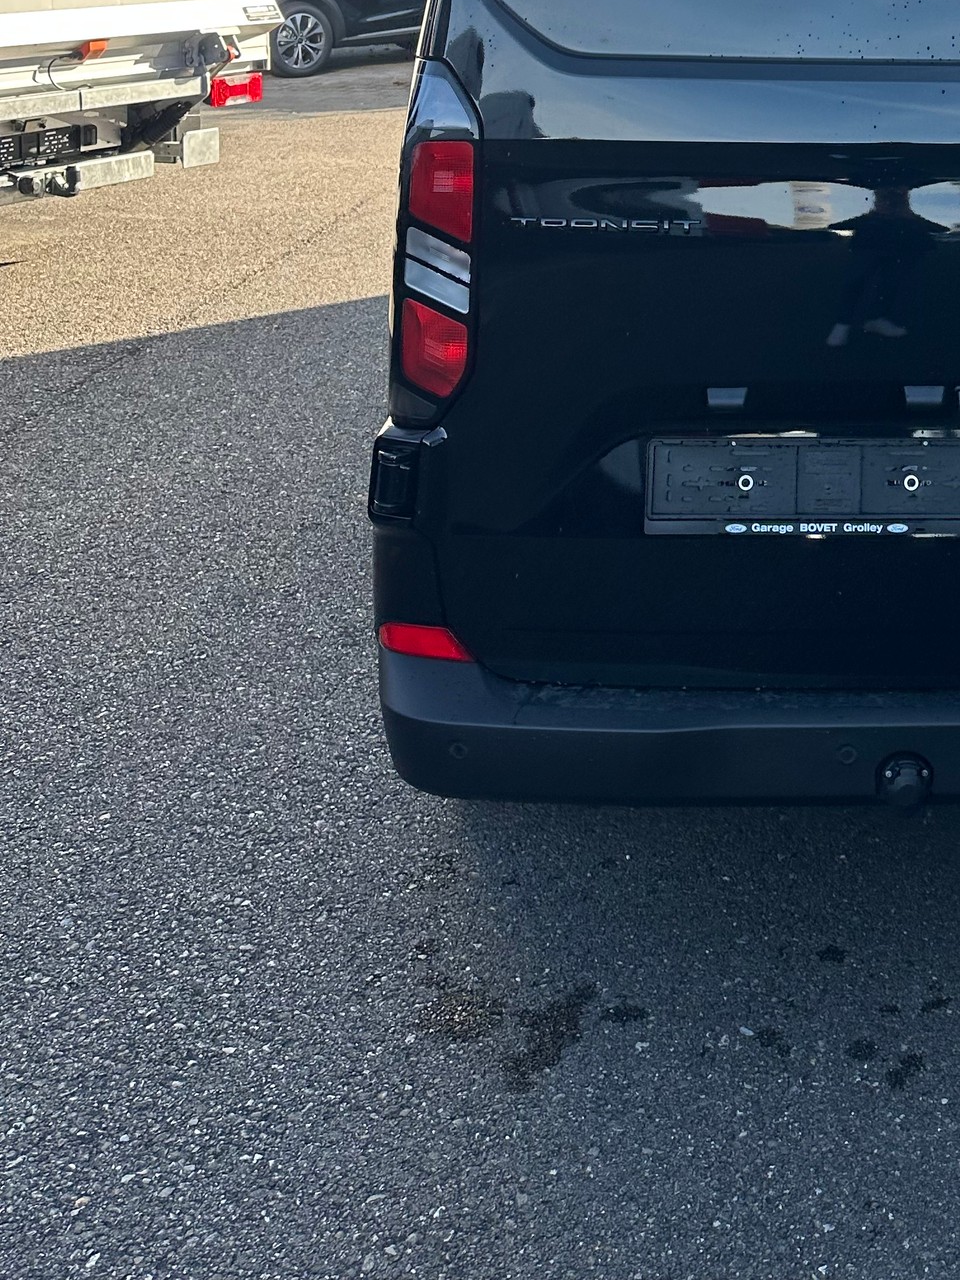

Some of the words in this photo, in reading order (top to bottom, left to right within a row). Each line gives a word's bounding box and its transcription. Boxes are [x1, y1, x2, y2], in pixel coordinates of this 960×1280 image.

[751, 522, 794, 534] Garage
[799, 522, 838, 532] BOVET
[843, 522, 884, 534] Grolley
